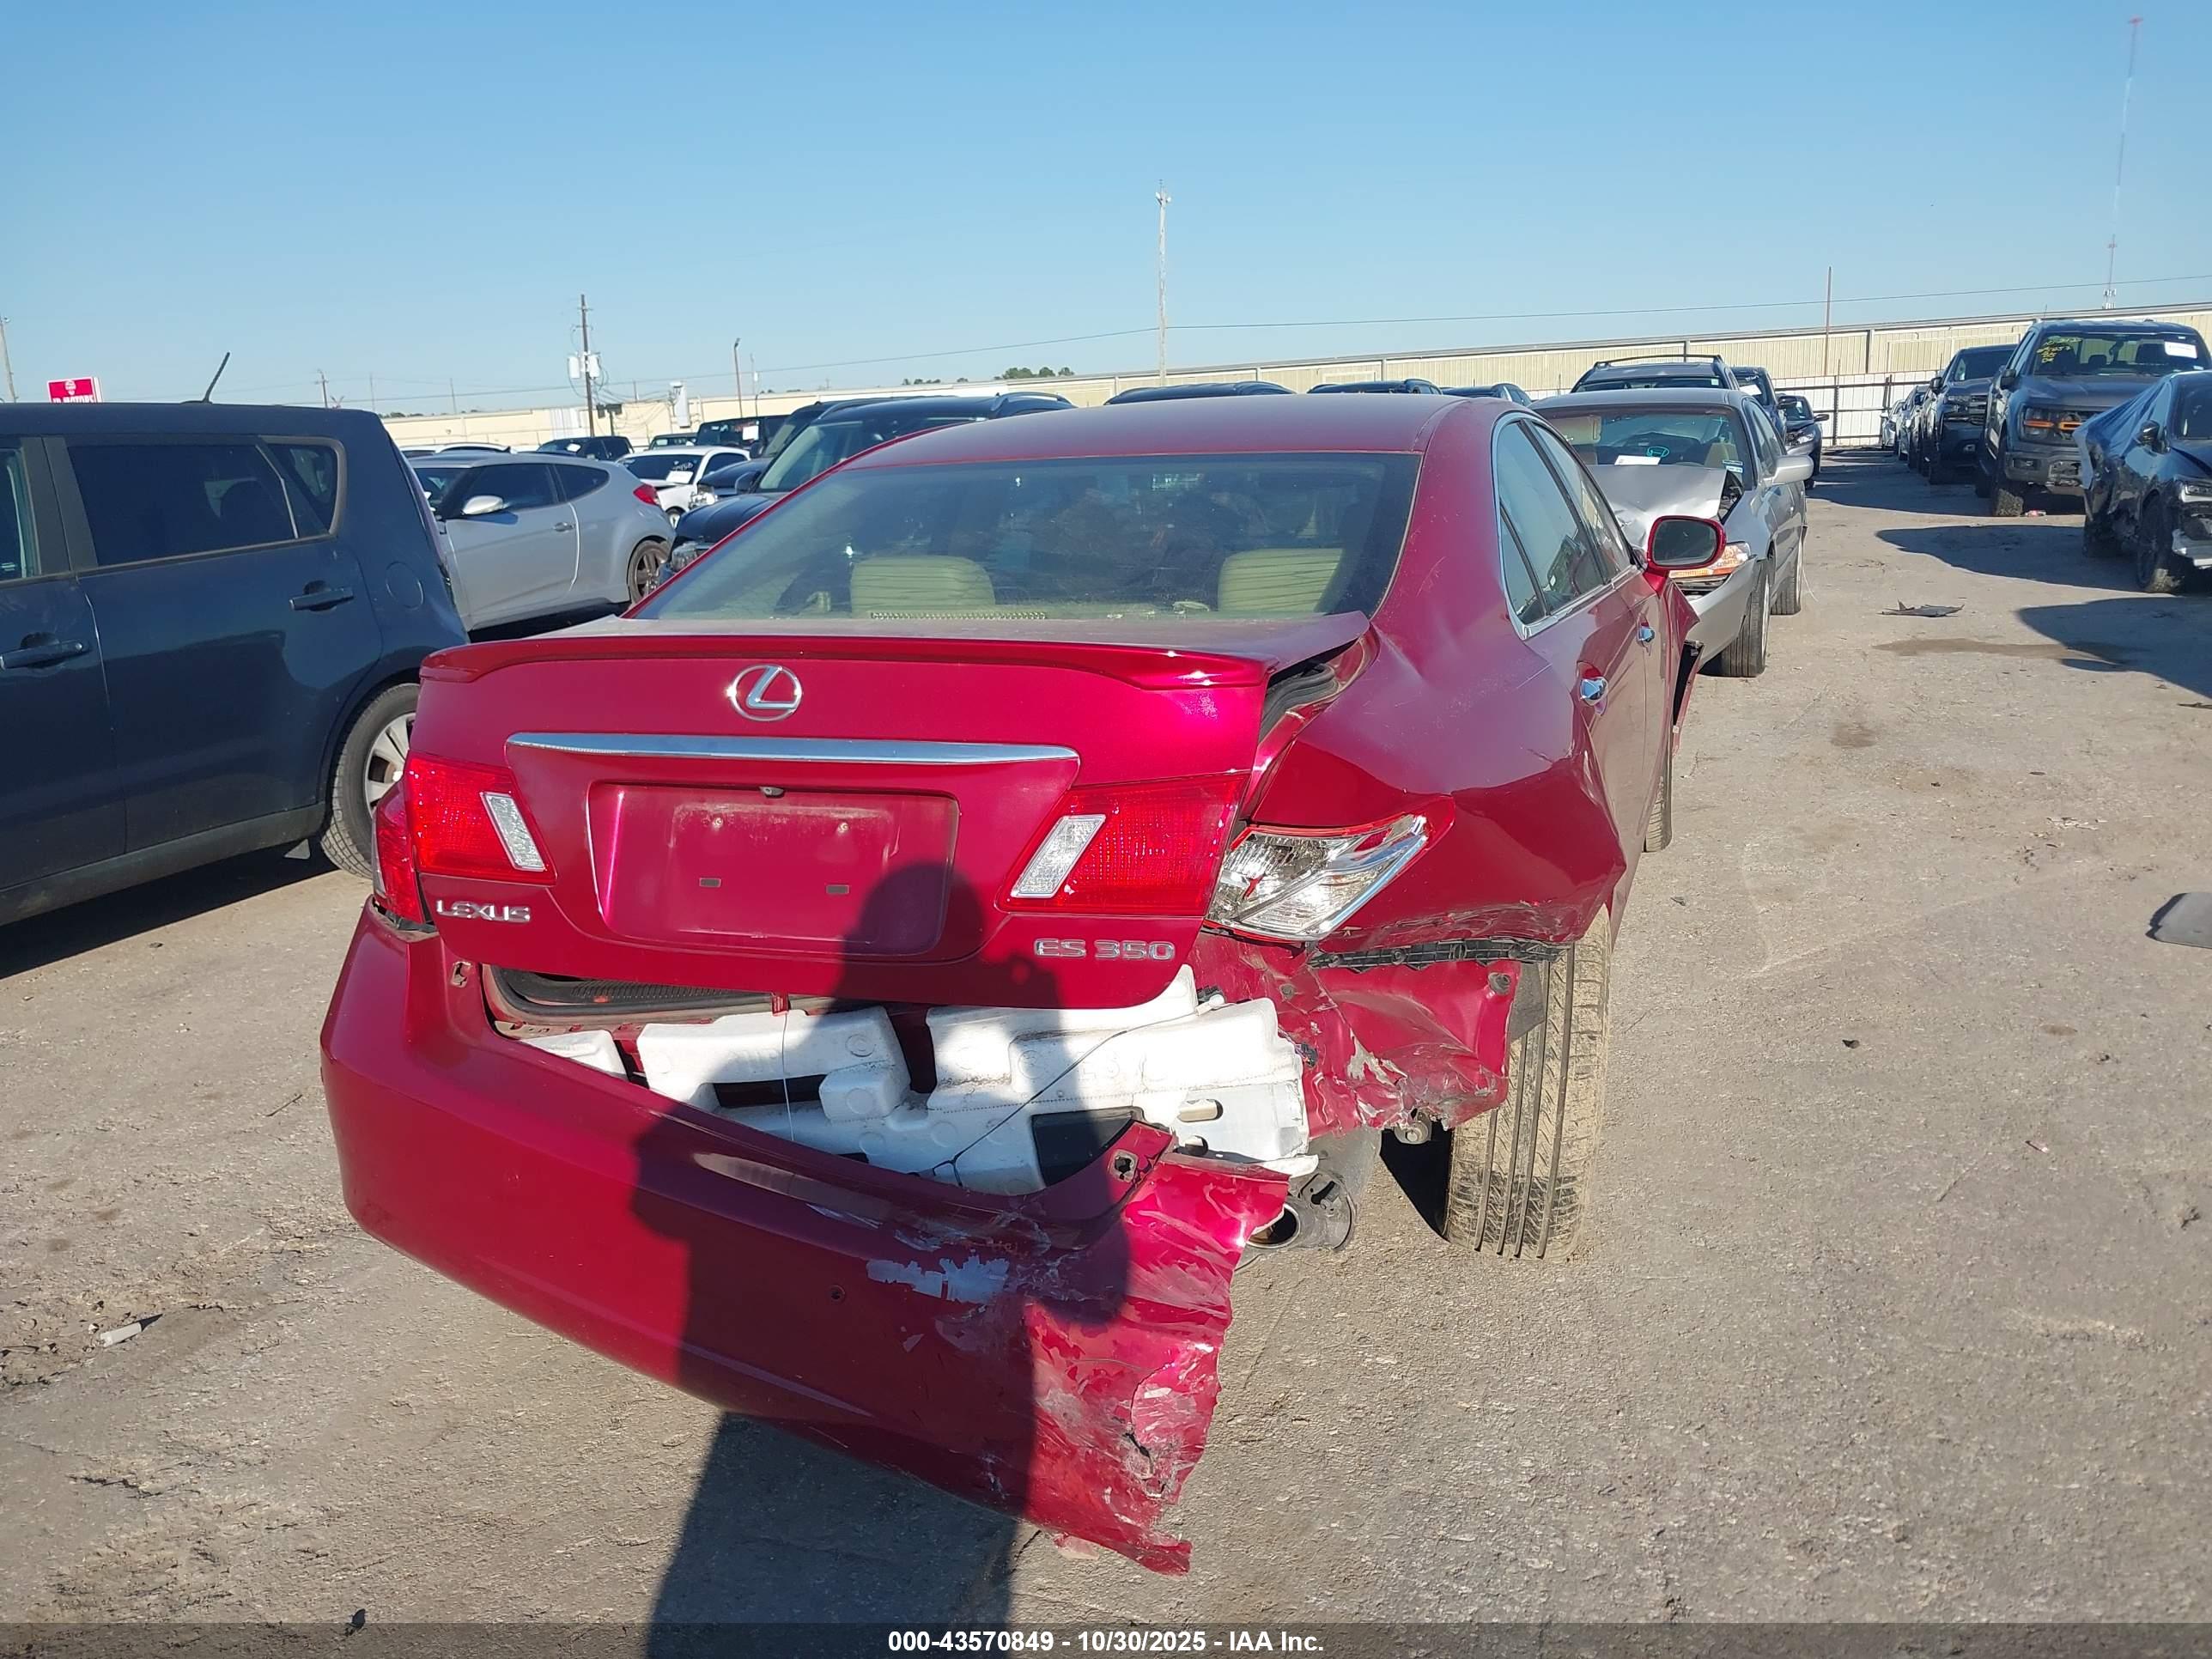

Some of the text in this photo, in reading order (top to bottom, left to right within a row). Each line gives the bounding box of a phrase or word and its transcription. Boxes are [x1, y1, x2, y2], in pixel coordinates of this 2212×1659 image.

[436, 900, 531, 923] LEXUS
[1034, 938, 1175, 960] ES 350
